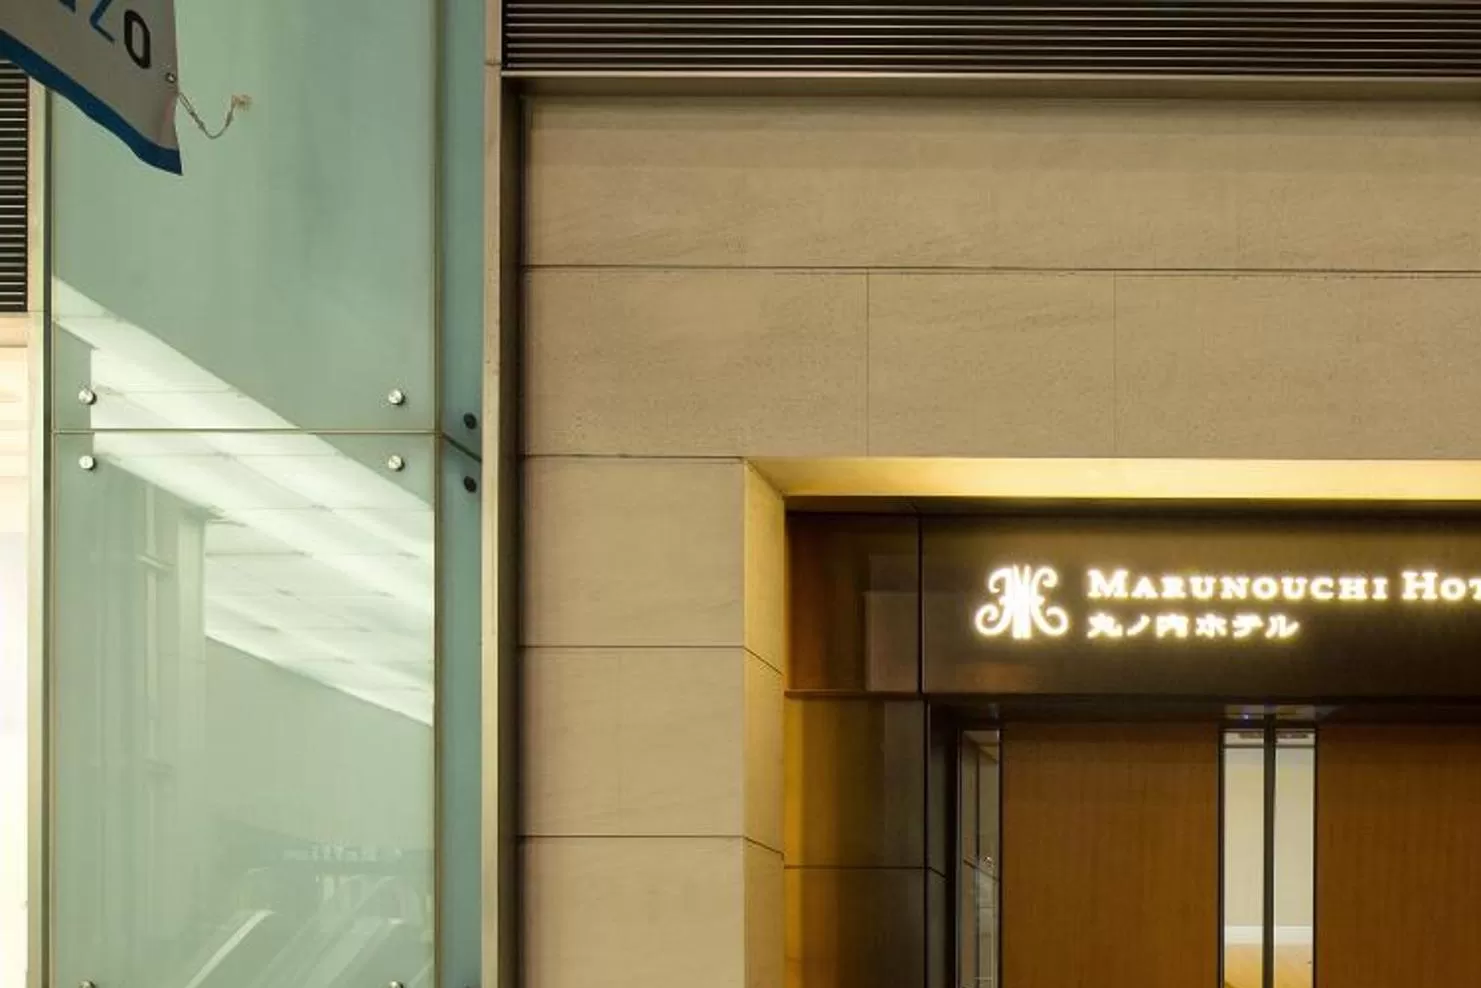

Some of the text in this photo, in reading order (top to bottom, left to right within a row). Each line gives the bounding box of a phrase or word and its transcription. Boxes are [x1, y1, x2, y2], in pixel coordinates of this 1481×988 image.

[1087, 568, 1388, 601] MARUNOUCHI
[1087, 611, 1300, 639] 丸ノ内ホテル
